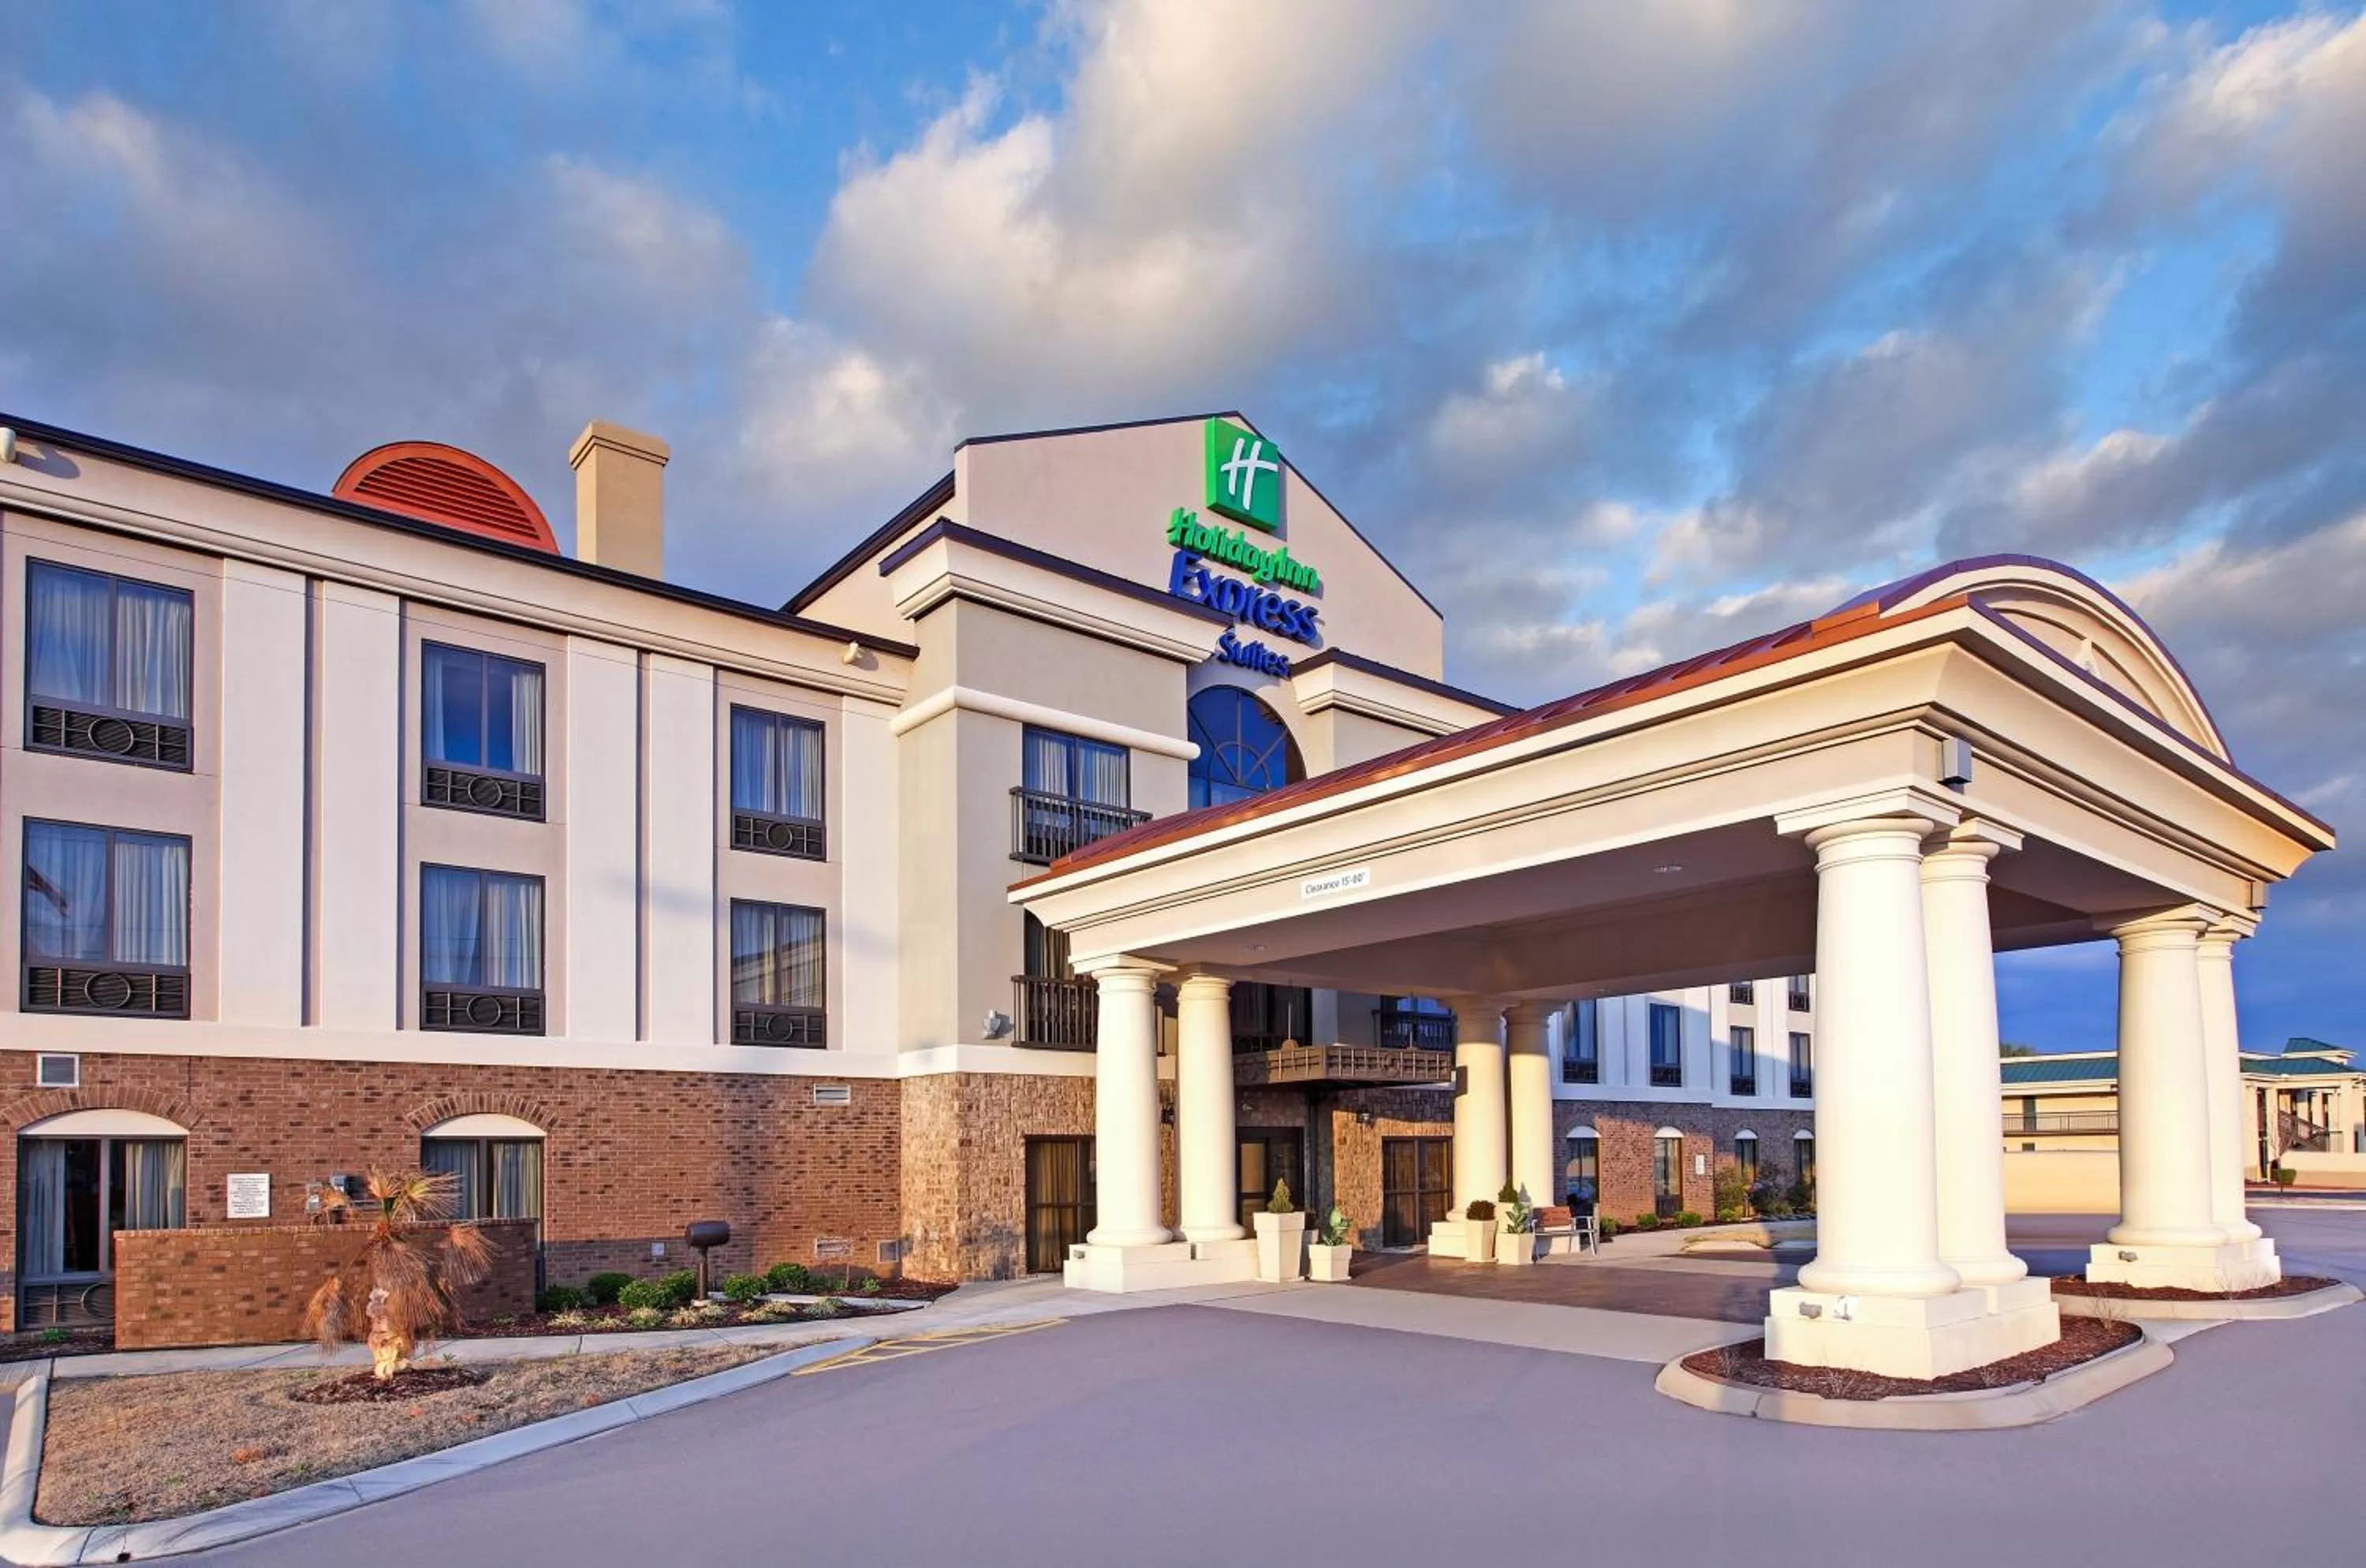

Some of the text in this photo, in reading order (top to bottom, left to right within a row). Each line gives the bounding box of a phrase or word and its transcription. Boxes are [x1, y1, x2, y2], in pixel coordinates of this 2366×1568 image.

[1167, 507, 1320, 591] Holiday Inn
[1170, 547, 1319, 642] Express
[1217, 631, 1290, 677] Suites
